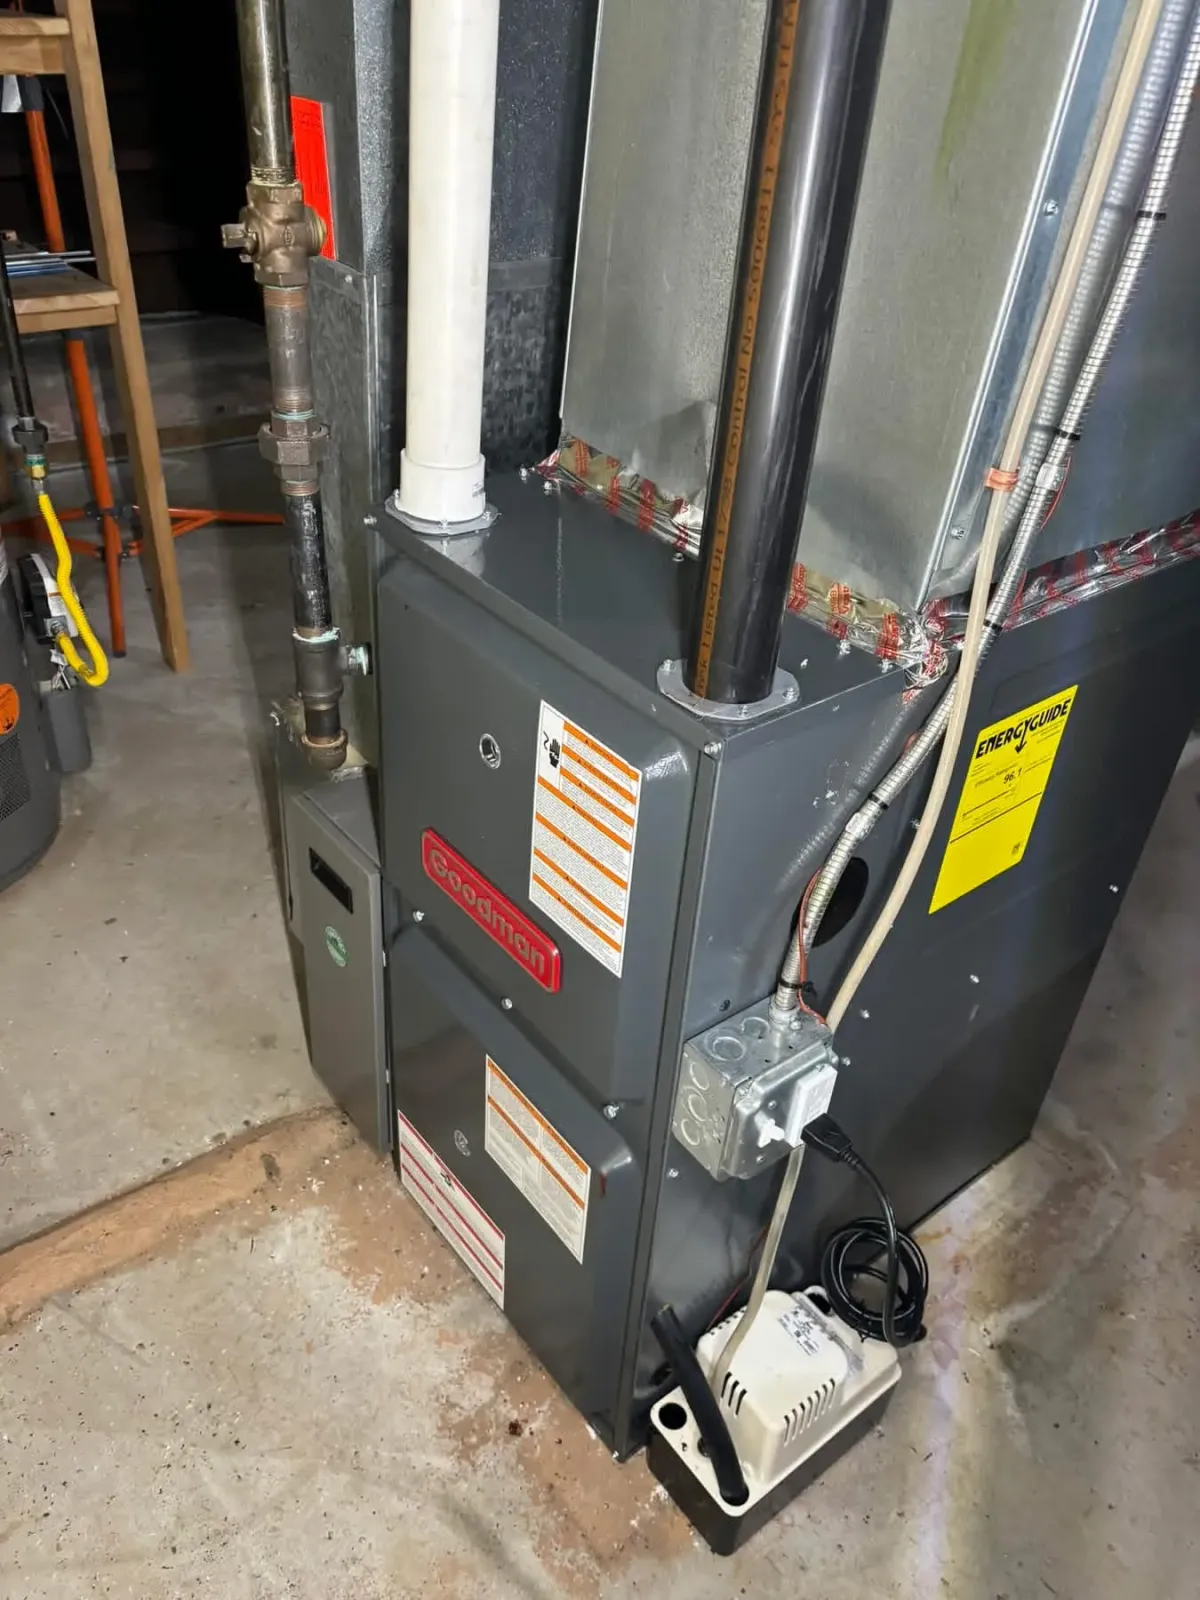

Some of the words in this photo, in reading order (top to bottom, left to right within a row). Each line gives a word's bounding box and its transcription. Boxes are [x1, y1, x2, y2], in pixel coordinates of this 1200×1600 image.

[712, 548, 725, 571] UL
[727, 367, 748, 466] Control
[1003, 767, 1023, 784] 96.1
[430, 849, 546, 977] Goodman
